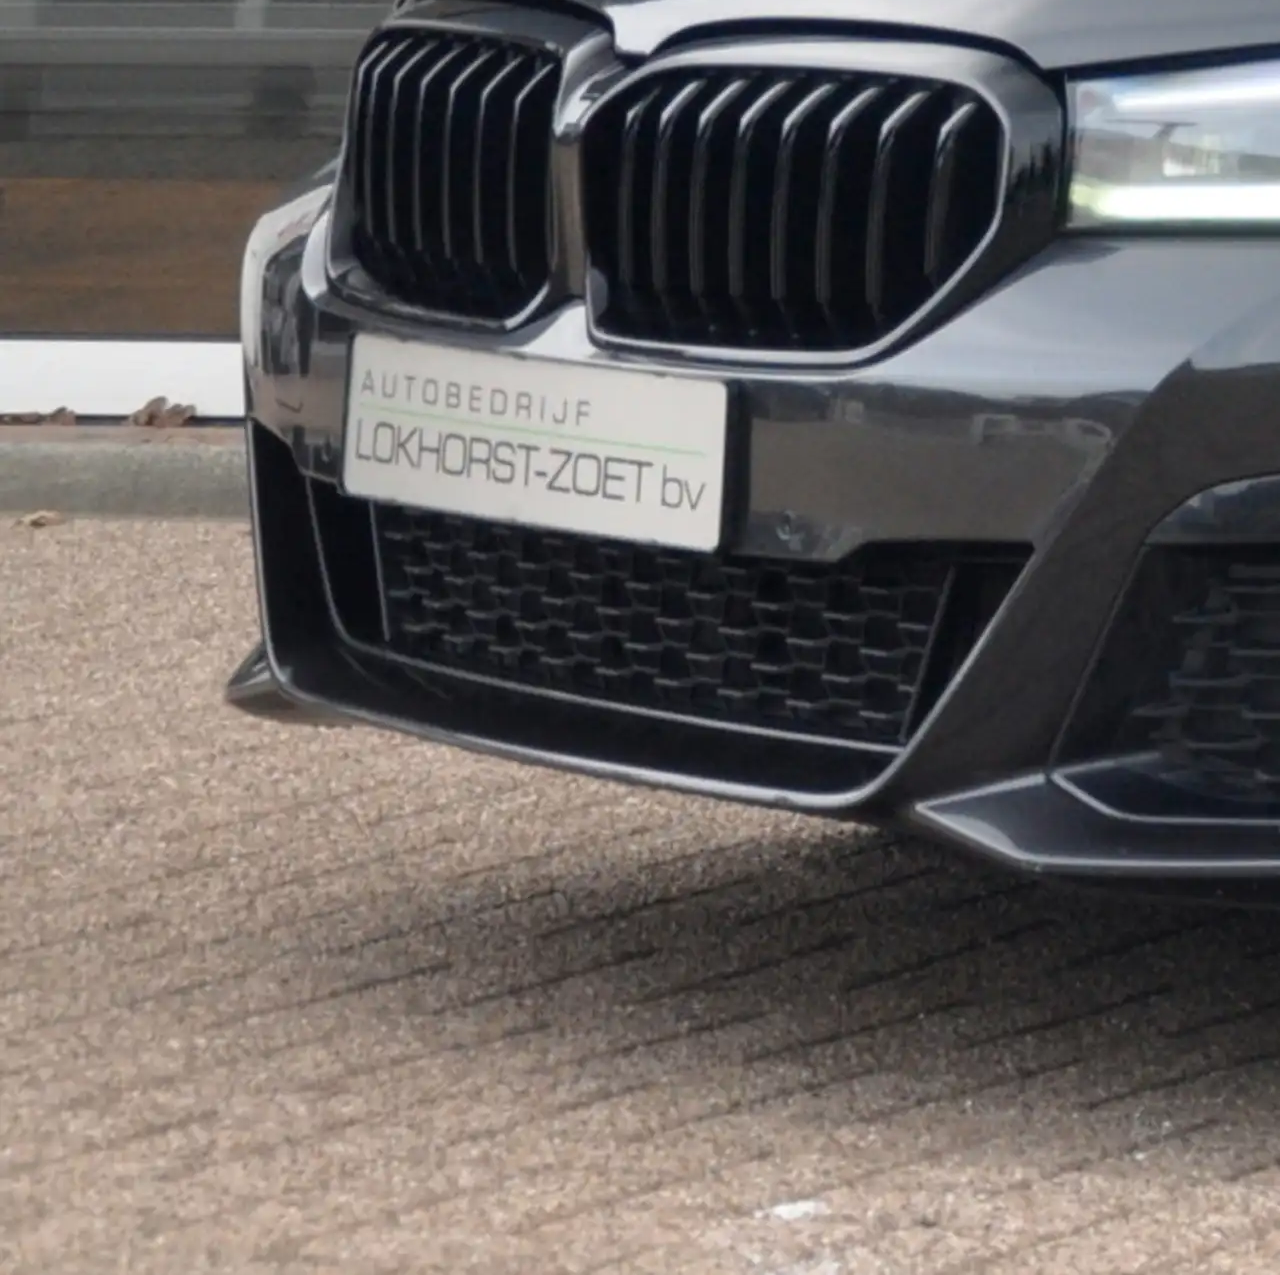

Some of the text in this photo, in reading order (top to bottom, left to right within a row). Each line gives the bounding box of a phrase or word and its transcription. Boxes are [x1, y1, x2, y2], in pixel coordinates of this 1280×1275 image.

[360, 367, 592, 426] AUTOBEDRIJF
[355, 417, 707, 512] LOKHORST-ZOET bv
